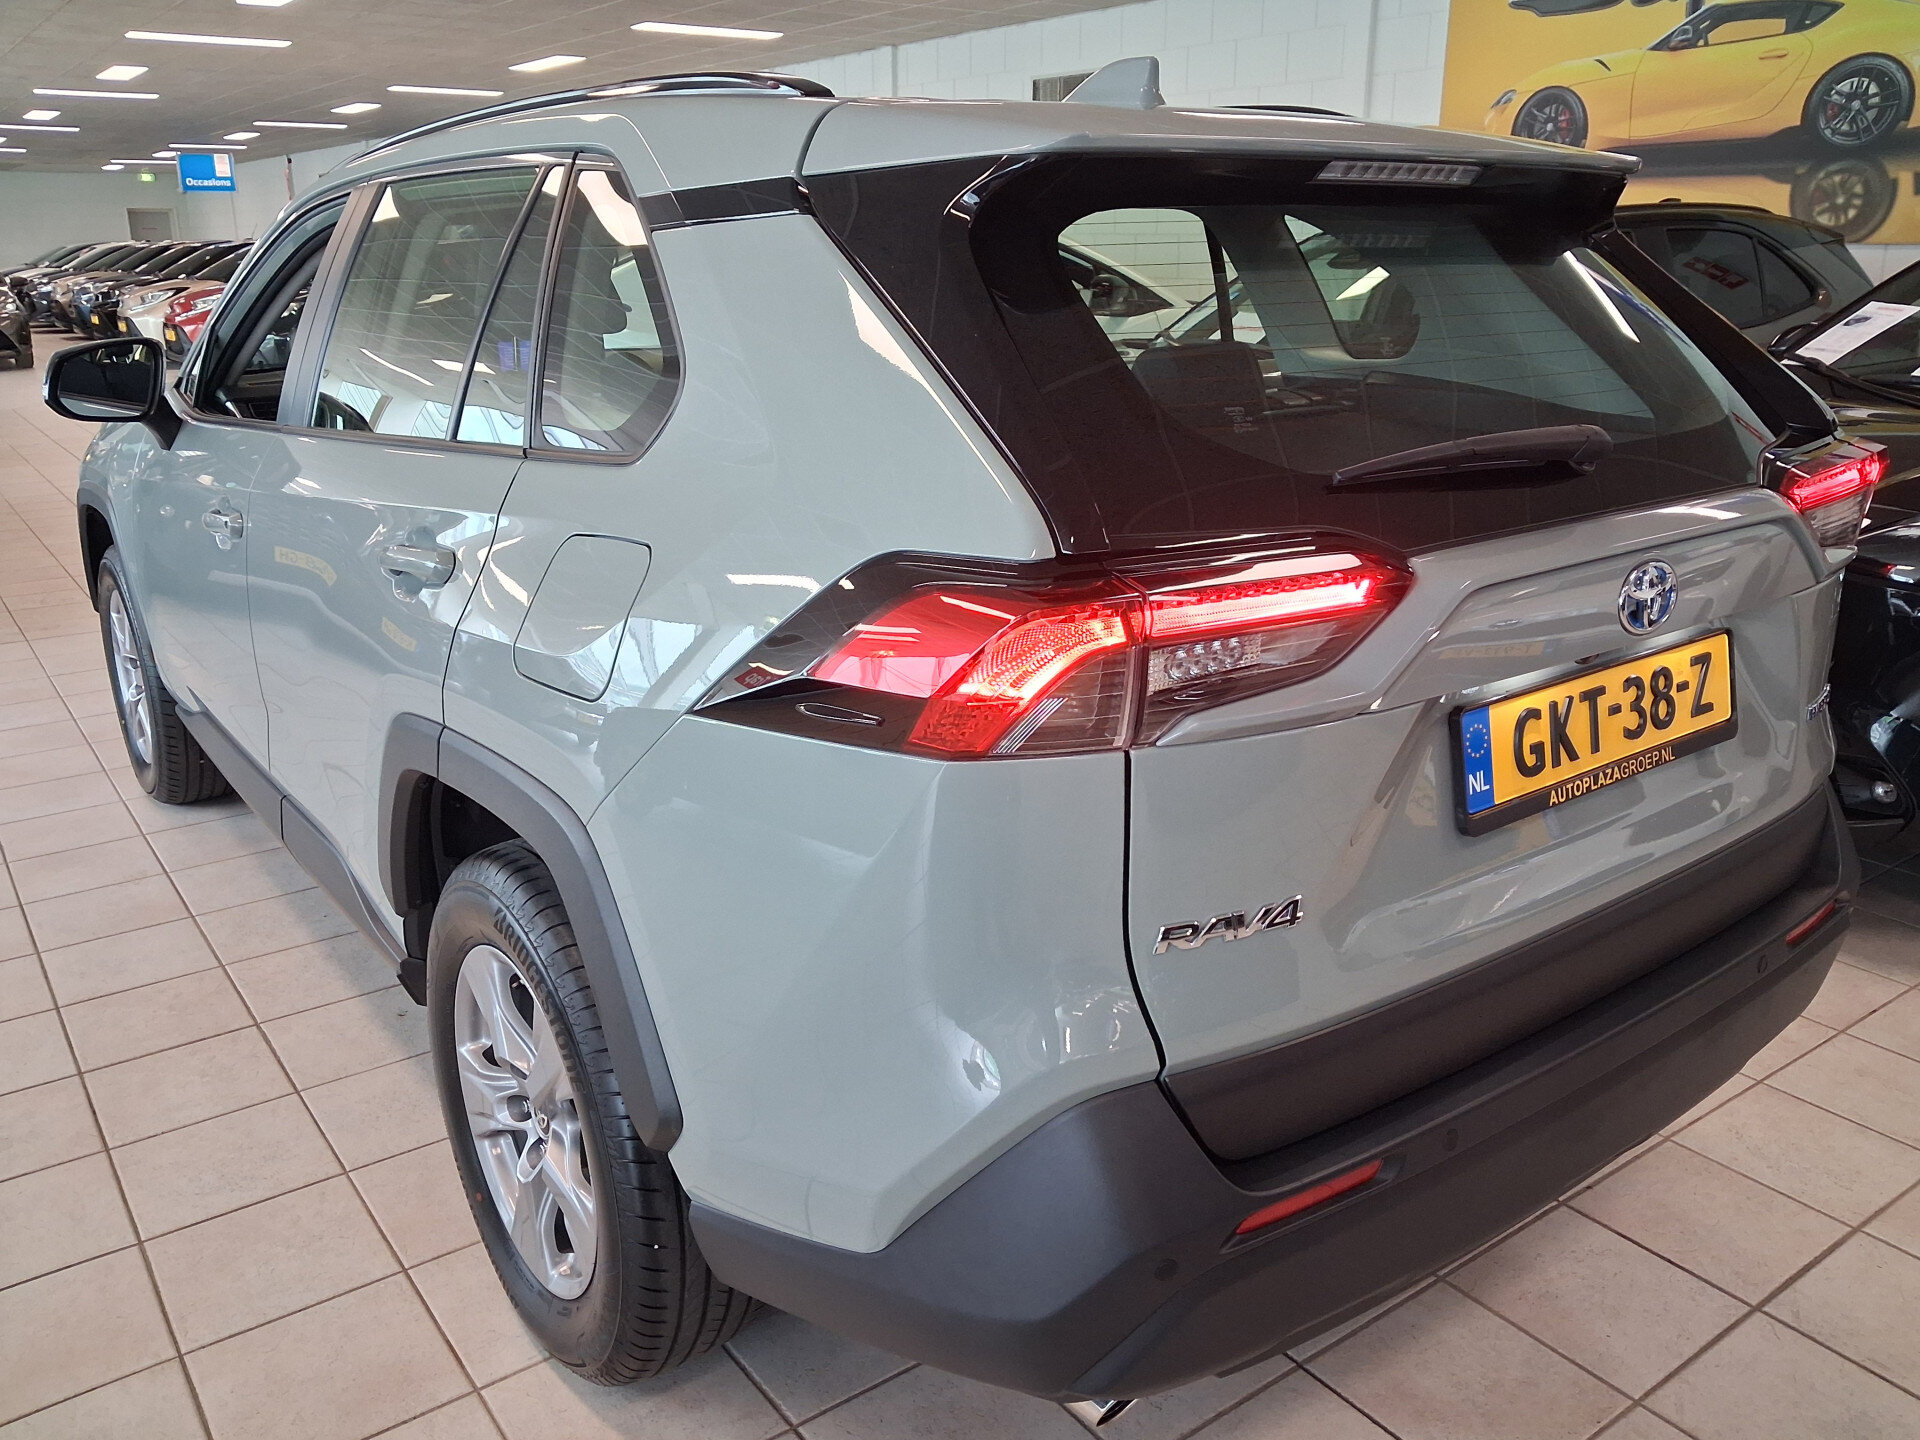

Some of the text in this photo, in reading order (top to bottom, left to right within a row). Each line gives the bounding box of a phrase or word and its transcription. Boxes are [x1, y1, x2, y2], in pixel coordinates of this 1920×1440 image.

[185, 177, 231, 187] Occasions
[1513, 652, 1715, 778] GKT-38-Z
[1468, 770, 1490, 795] NL
[1549, 746, 1676, 806] AUTOPLAZAGROEP.NL
[1152, 894, 1304, 956] RAV4
[493, 906, 588, 1094] BRIDGESTONE
